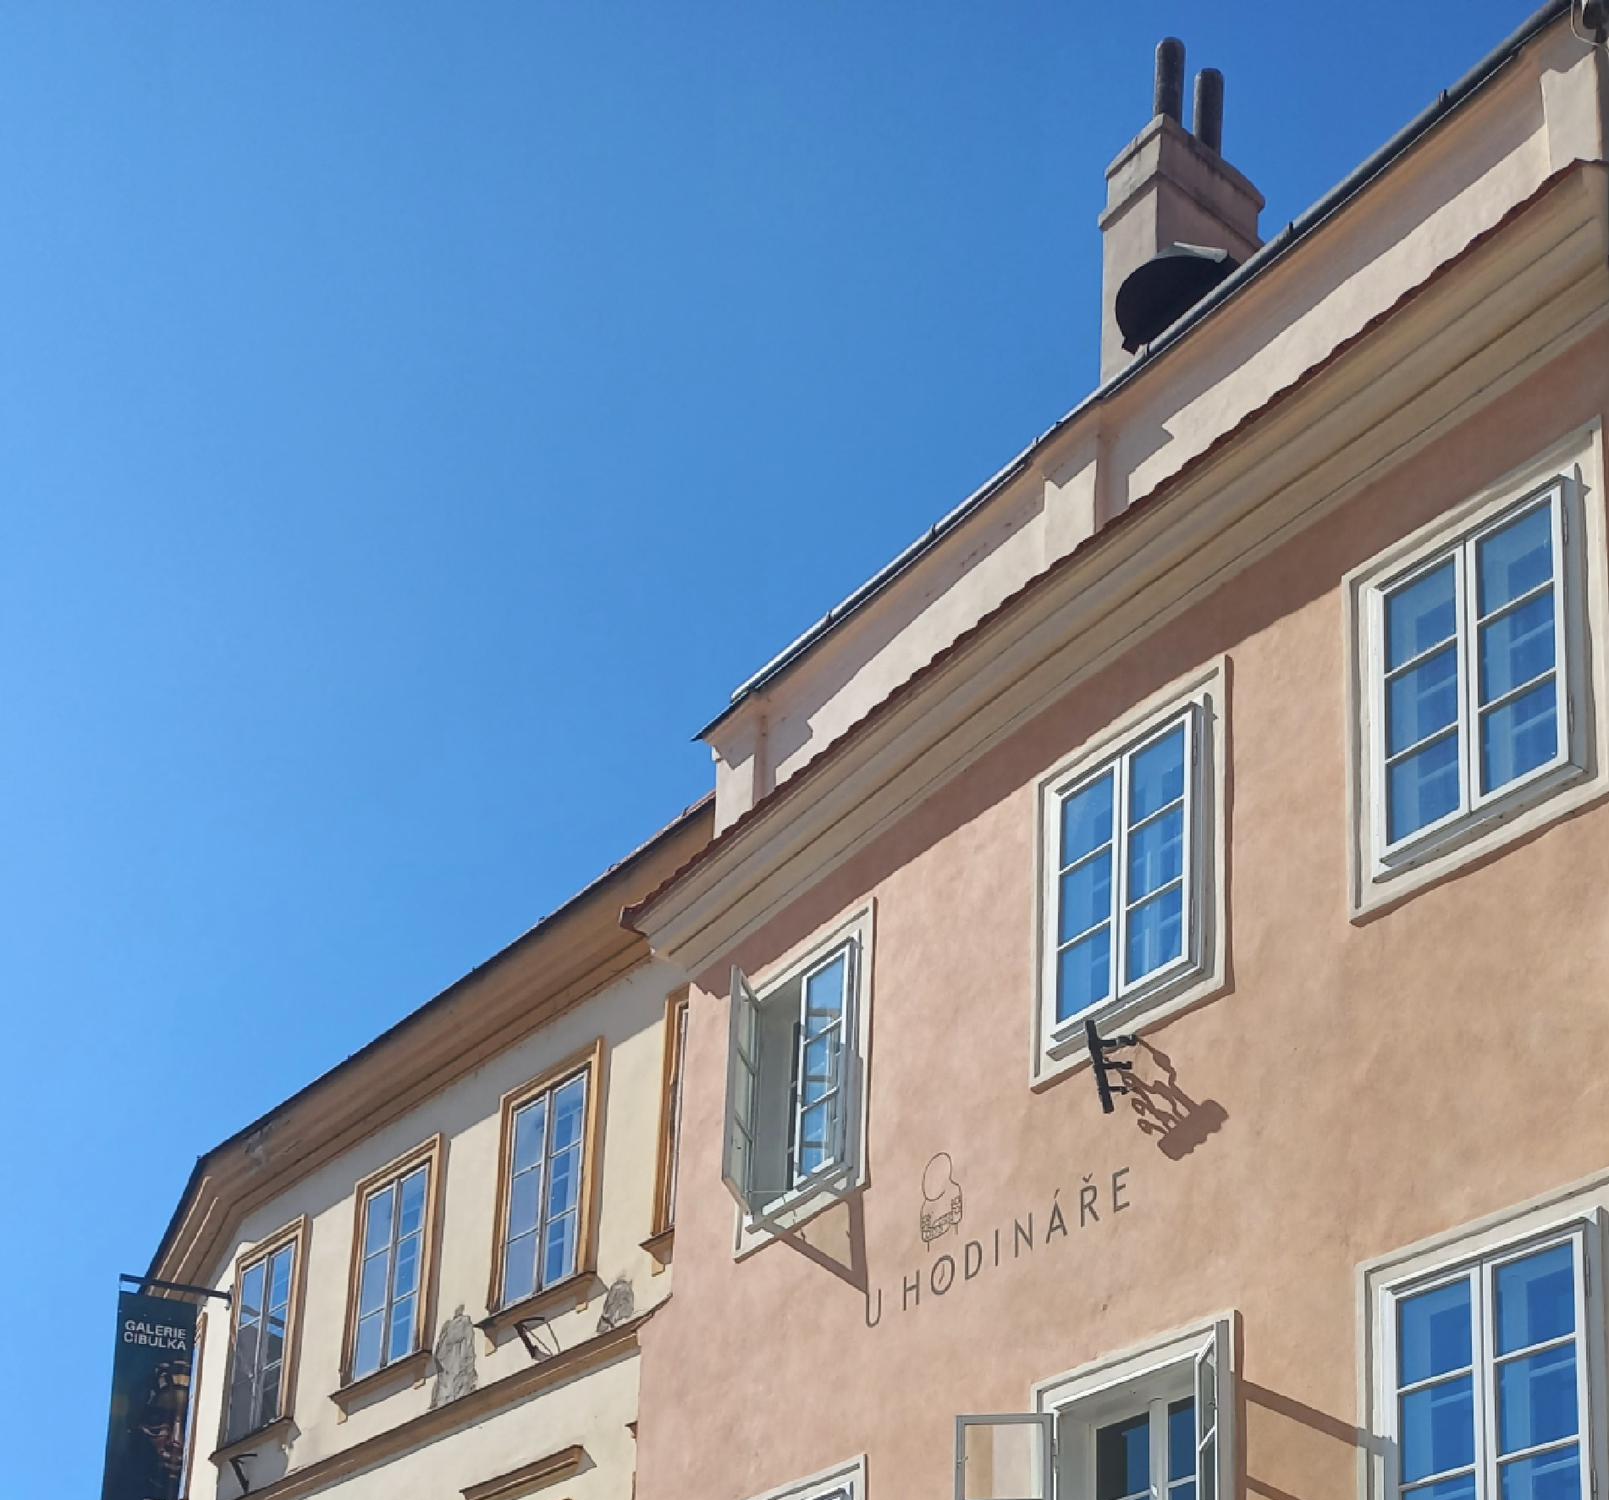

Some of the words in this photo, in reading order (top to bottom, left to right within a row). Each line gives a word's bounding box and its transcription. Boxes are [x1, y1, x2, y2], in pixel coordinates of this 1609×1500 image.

[866, 1288, 882, 1328] U
[902, 1167, 1131, 1311] HODINÁŘE
[124, 1319, 187, 1340] GALERIE
[123, 1331, 187, 1350] CIBULKA
